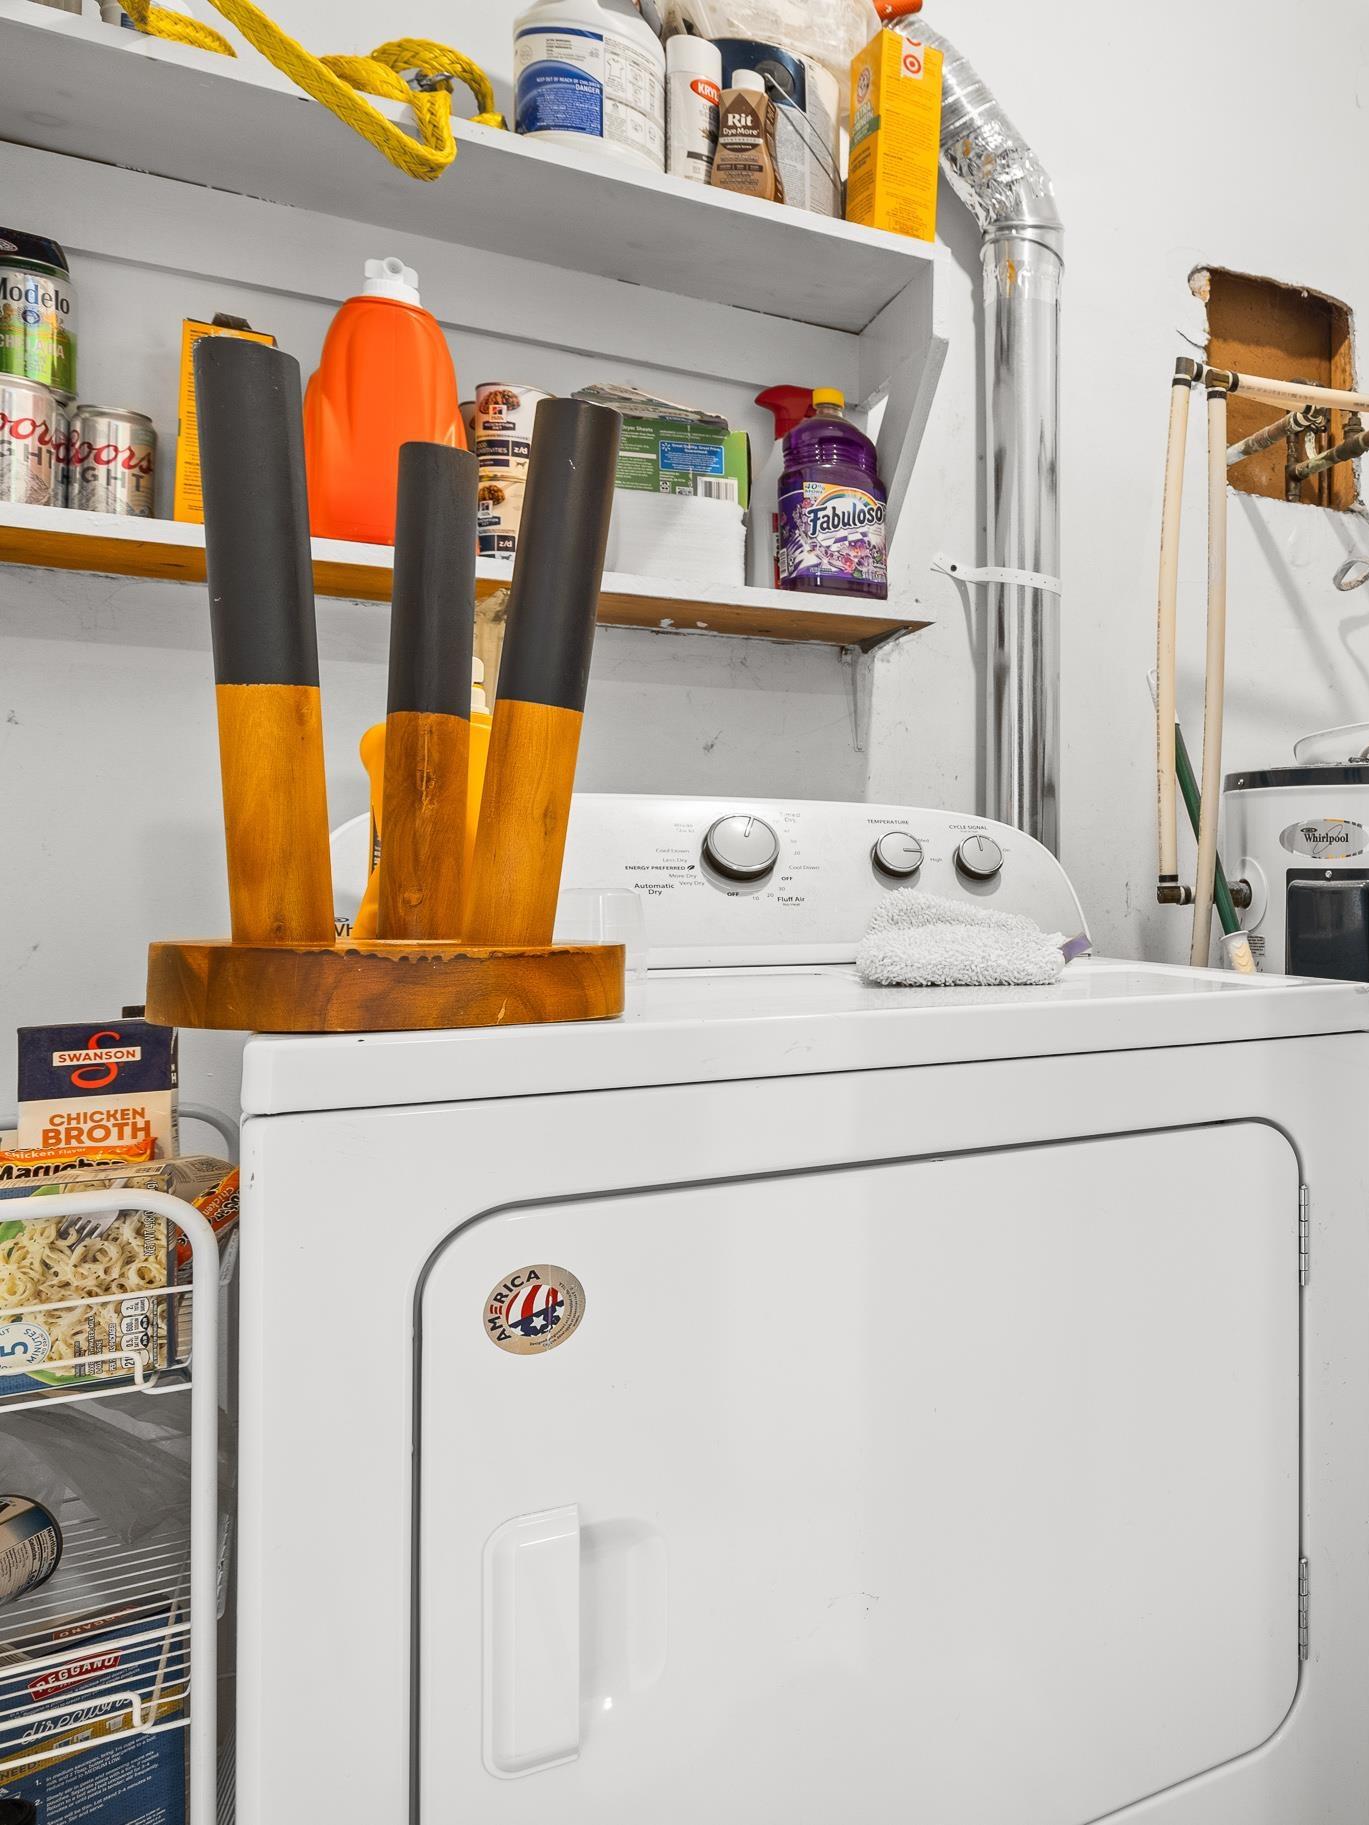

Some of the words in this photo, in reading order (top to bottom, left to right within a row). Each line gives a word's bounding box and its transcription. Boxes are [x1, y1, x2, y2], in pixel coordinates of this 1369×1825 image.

[576, 84, 600, 94] DANGER
[697, 81, 719, 101] KRYL
[727, 113, 753, 127] Rit
[0, 440, 56, 469] GHT
[806, 503, 883, 535] Fabuloso
[1304, 833, 1349, 845] Whirlpool
[58, 1049, 137, 1064] SWANSON
[49, 1107, 146, 1127] CHICKEN
[42, 1119, 152, 1149] BROTH
[4, 1150, 55, 1160] Chicken
[0, 1157, 126, 1181] Maruch
[487, 1269, 541, 1342] AMERICA
[24, 1328, 43, 1364] MINUTES
